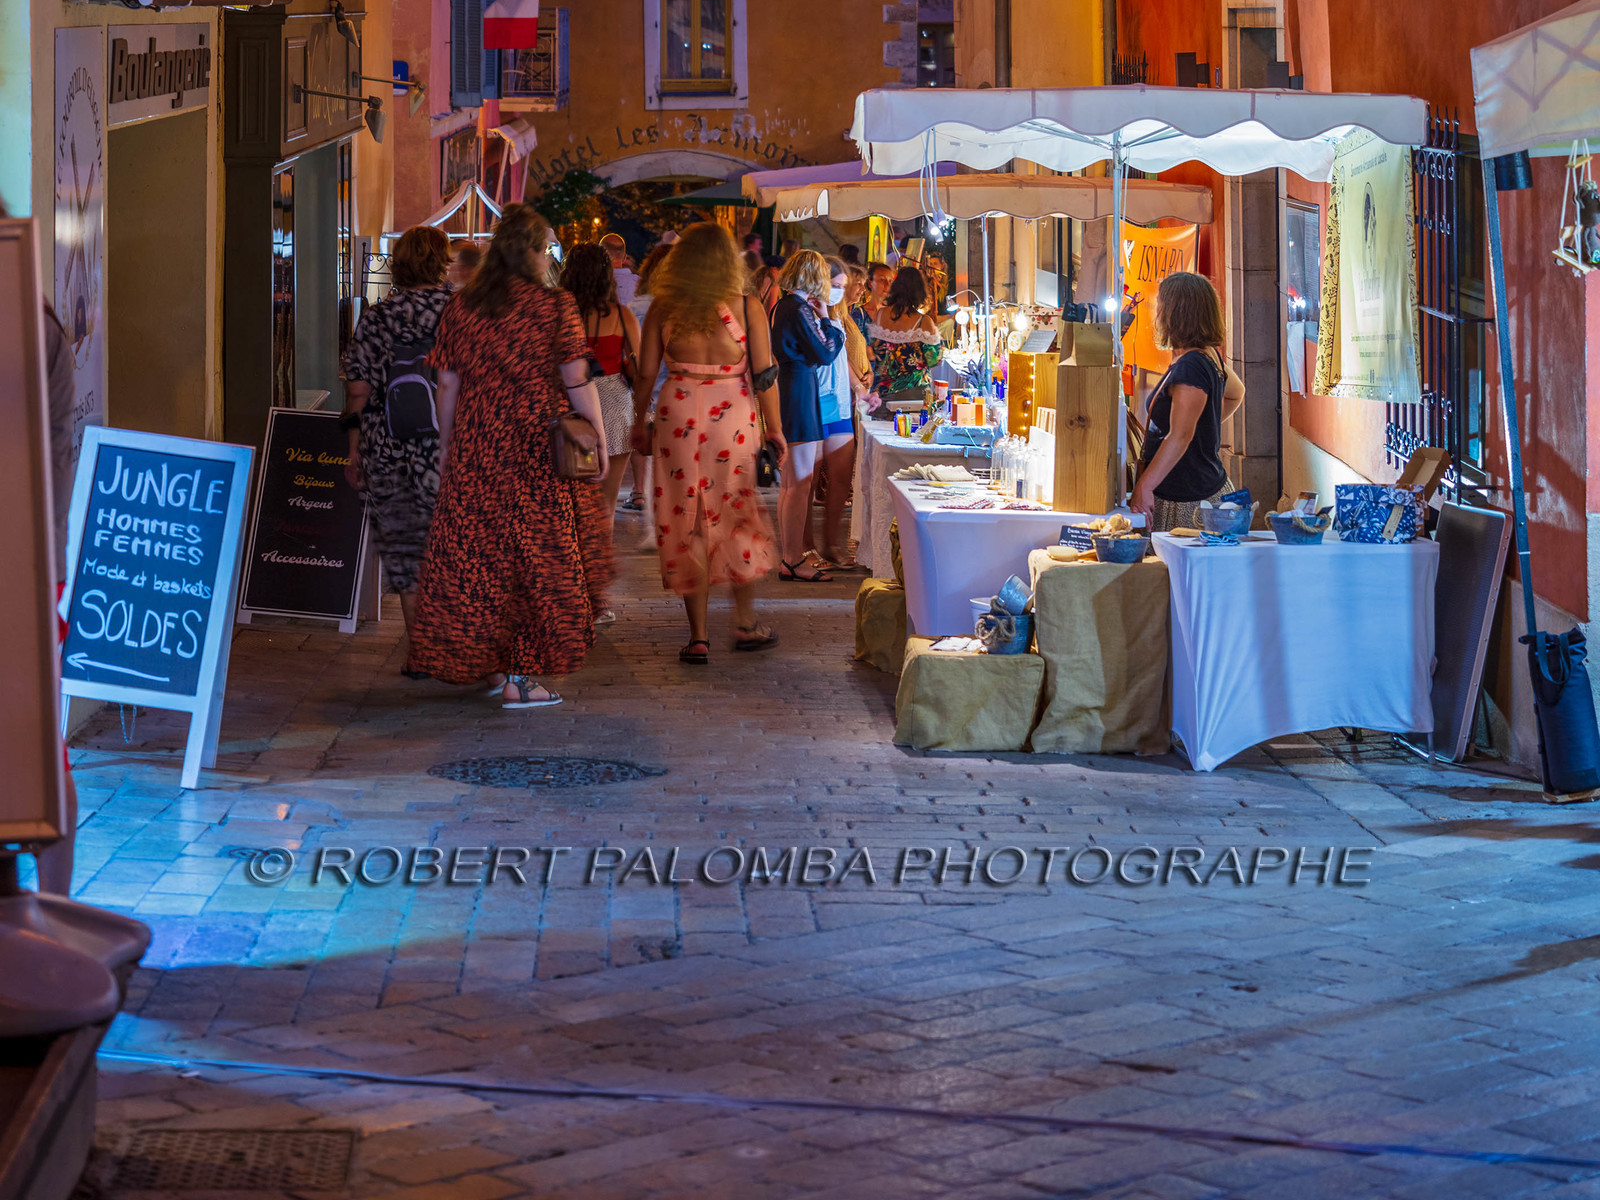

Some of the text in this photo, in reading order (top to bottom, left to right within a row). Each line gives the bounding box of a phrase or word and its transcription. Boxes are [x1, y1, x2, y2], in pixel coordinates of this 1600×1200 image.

[109, 33, 211, 109] Boulangerie
[286, 447, 352, 466] Via luna
[98, 455, 224, 514] JUNGLE
[293, 474, 335, 488] Bijoux
[288, 495, 334, 510] Argent
[97, 507, 203, 544] HOMMES
[94, 530, 204, 566] FEMMES
[261, 550, 345, 568] Accessoires
[83, 557, 130, 582] Mode
[153, 576, 212, 600] baskets
[76, 589, 202, 659] SOLDES
